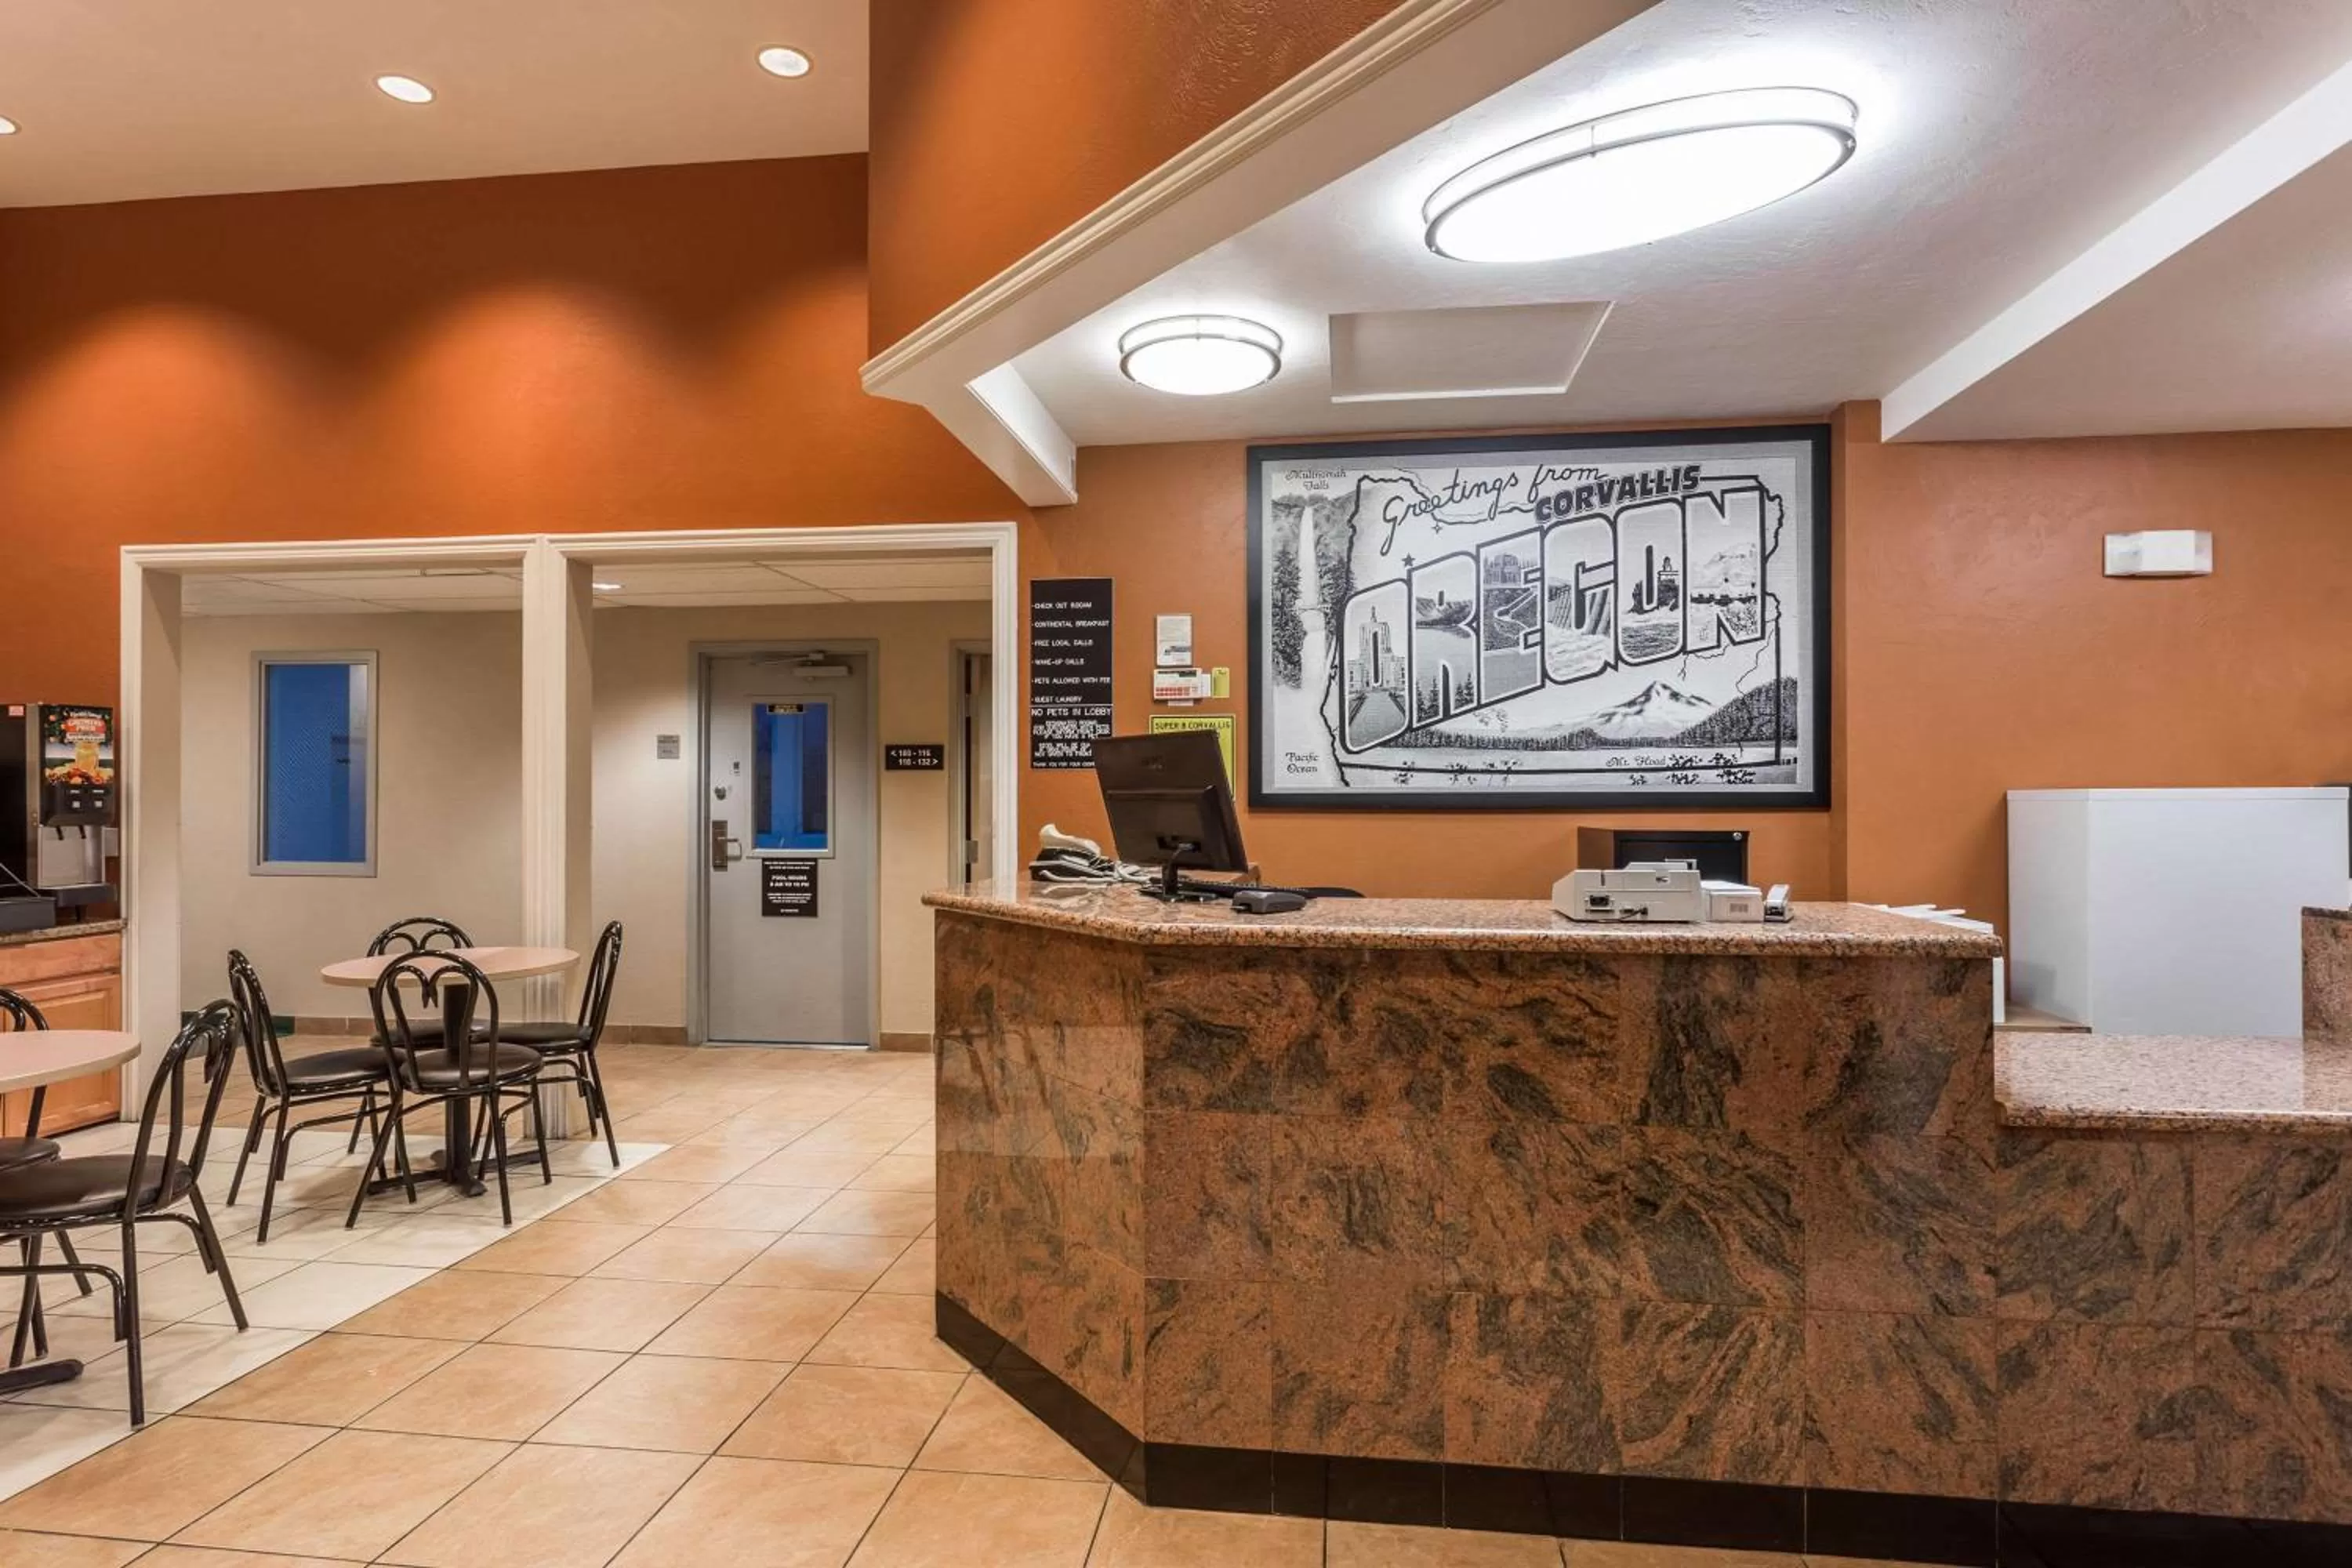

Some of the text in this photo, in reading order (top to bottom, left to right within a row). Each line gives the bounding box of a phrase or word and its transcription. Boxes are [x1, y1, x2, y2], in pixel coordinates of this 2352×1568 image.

[1534, 465, 1701, 521] CORVALLIS
[1381, 464, 1609, 557] Greetings from
[1339, 485, 1766, 754] OREGON
[1047, 708, 1069, 717] PETS
[1084, 707, 1112, 716] LOBBY
[1155, 720, 1180, 730] SUPER
[1188, 720, 1231, 729] CORVALLIS
[1285, 752, 1320, 764] Pacific
[1634, 755, 1667, 767] Hood
[1287, 763, 1319, 774] Ocean
